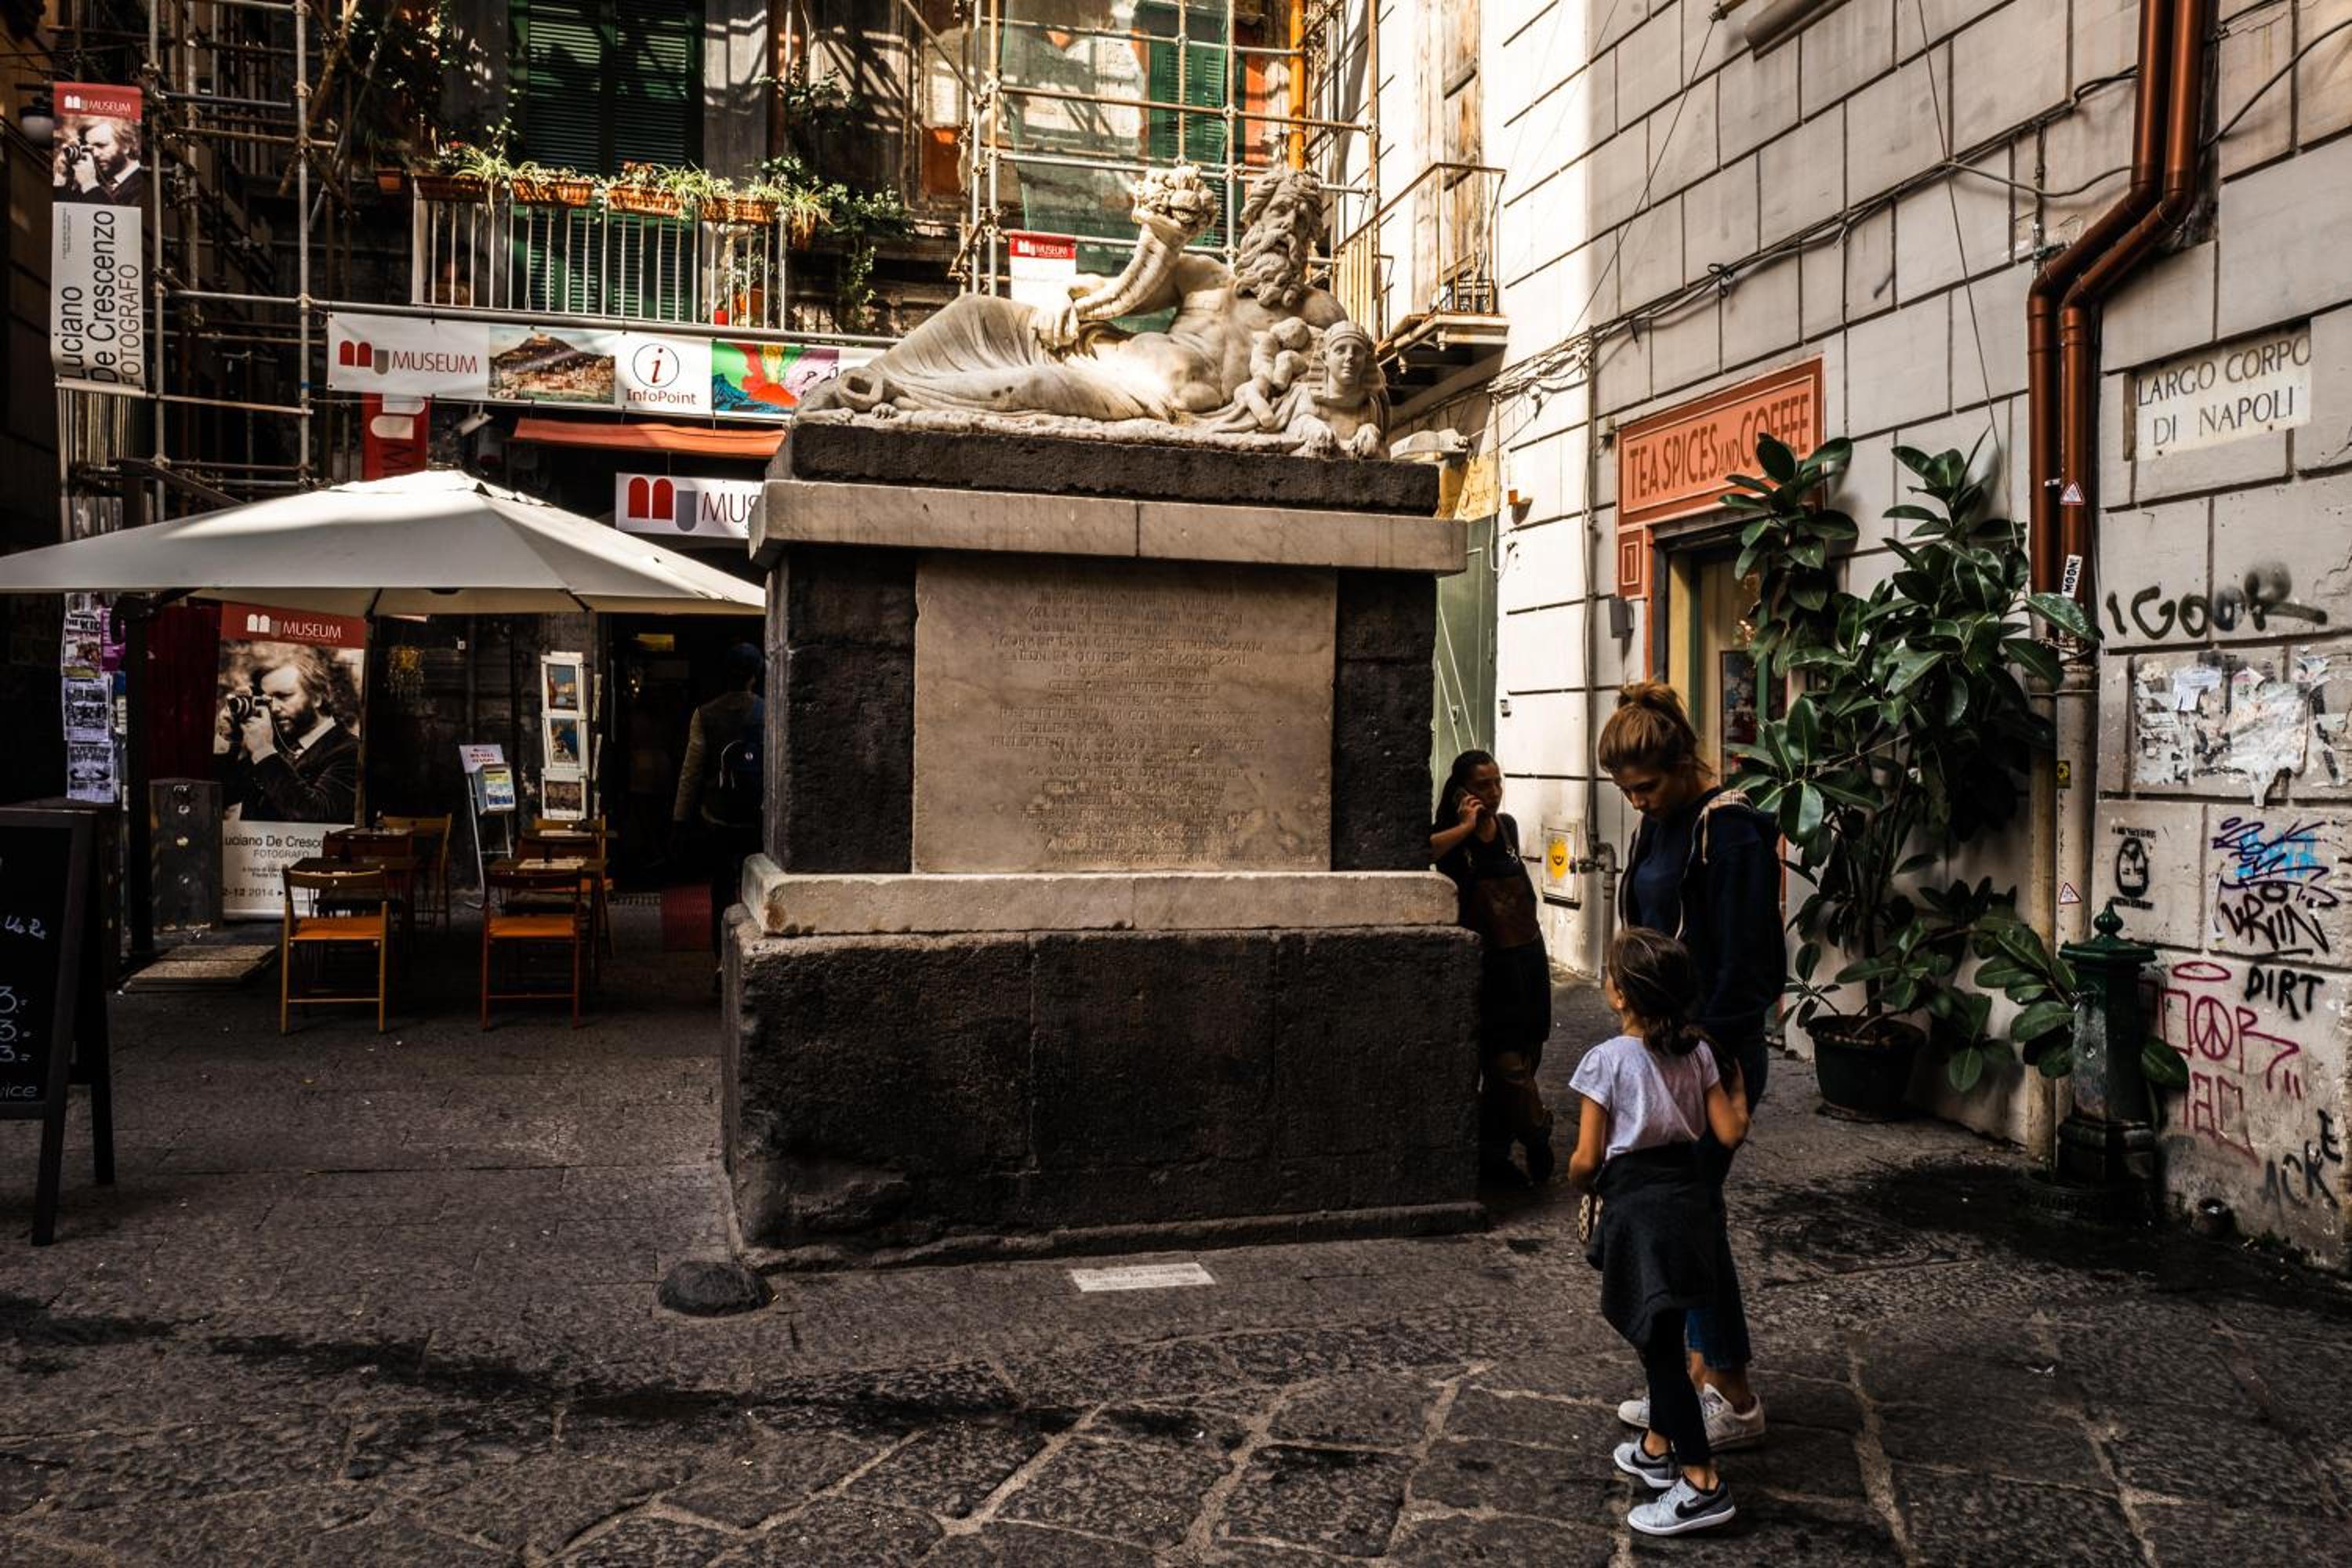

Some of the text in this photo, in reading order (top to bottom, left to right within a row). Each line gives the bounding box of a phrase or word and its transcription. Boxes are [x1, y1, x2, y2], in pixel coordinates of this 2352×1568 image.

[89, 99, 132, 114] MUSEUM
[86, 210, 118, 383] De Crescenzo
[118, 263, 142, 386] FOTOGRAFO
[55, 286, 87, 380] Luciano
[392, 350, 478, 375] MUSEUM
[627, 387, 697, 405] InfoPoint
[2137, 334, 2311, 407] LARGO CORPO
[2153, 385, 2294, 447] DI NAPOLI
[1629, 393, 1809, 501] TEA SPICES AND COFFEE
[282, 620, 342, 639] MUSEUM
[224, 834, 263, 846] uciano
[2243, 964, 2325, 1021] DIRT
